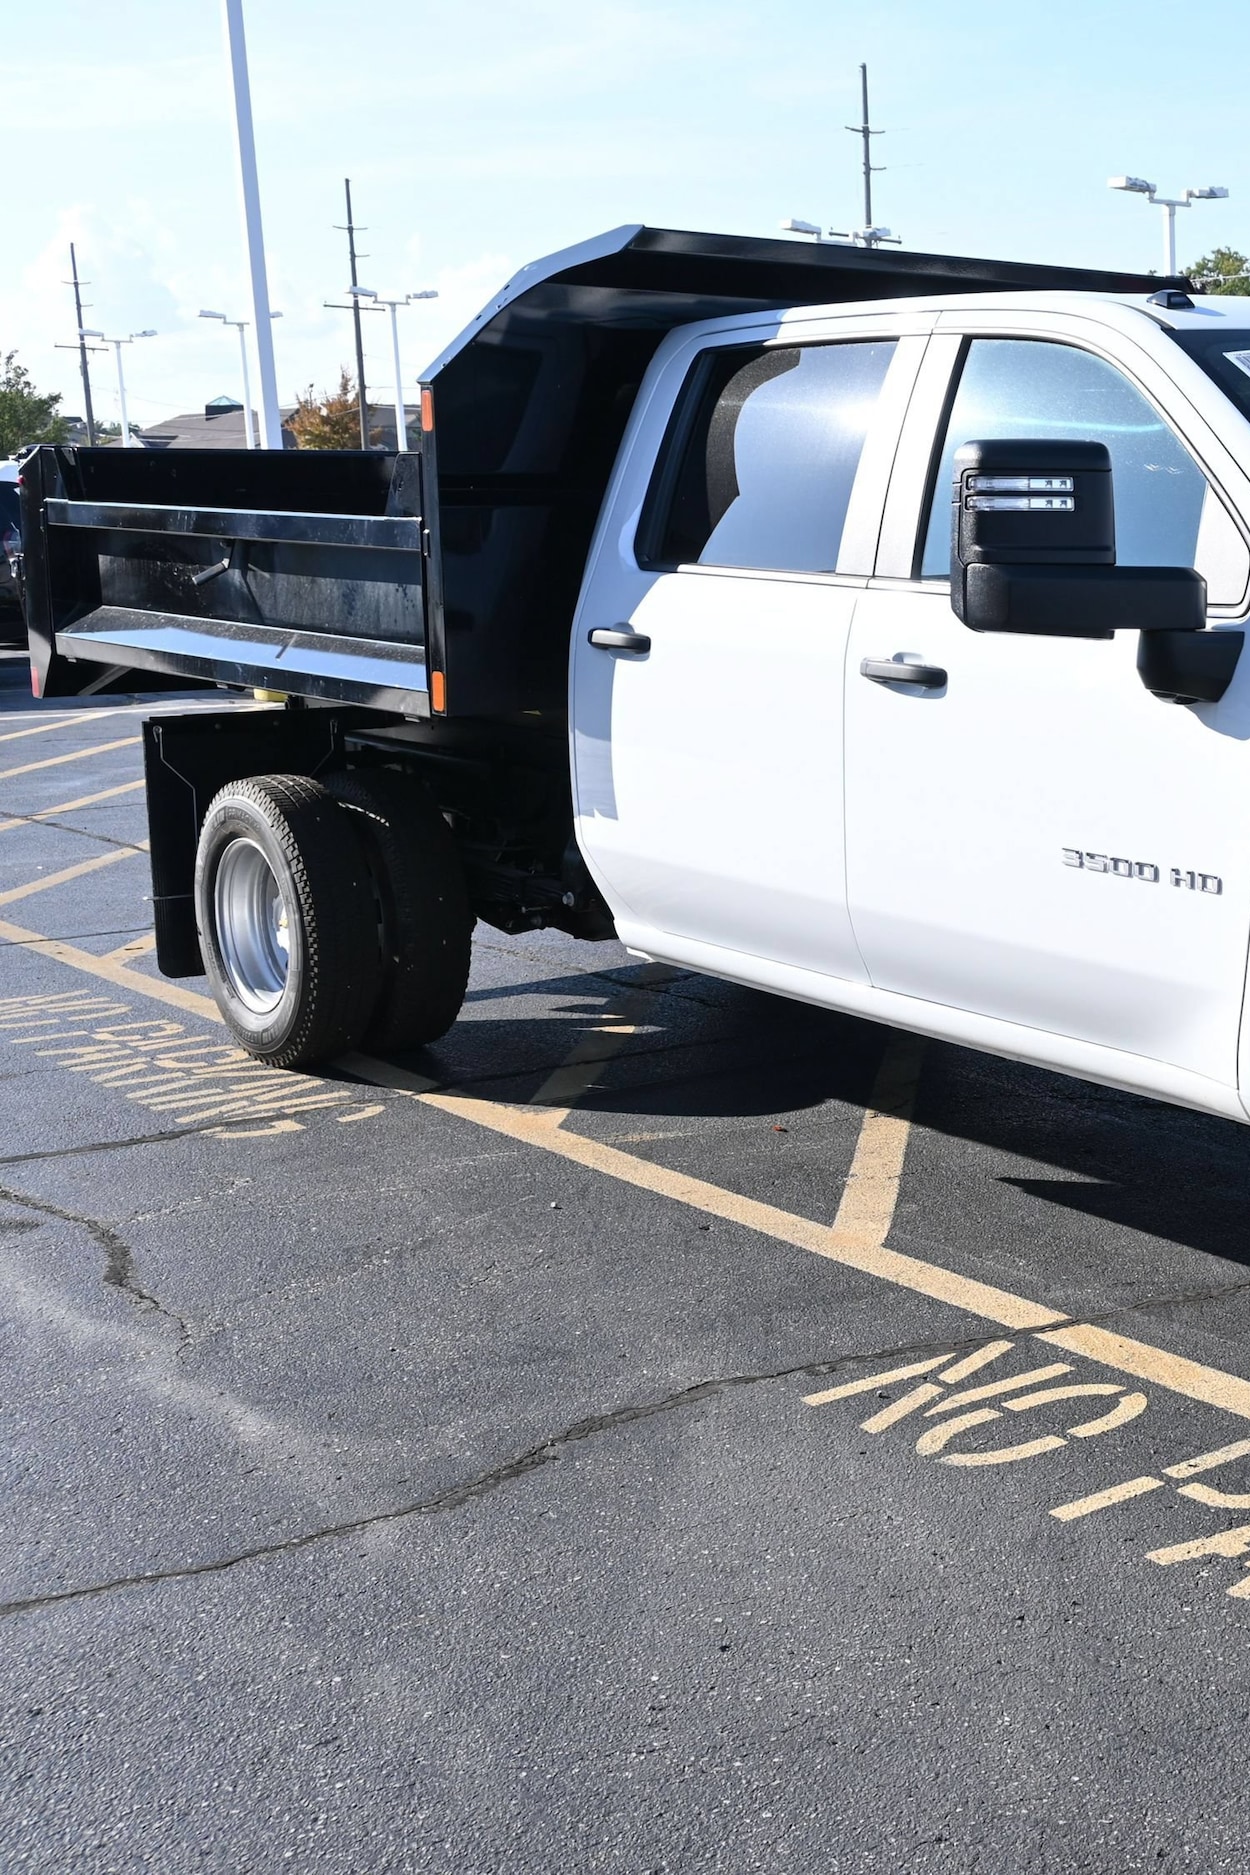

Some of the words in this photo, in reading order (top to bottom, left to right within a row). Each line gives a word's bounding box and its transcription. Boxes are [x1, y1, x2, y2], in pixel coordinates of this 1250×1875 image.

[1061, 847, 1160, 883] 3500
[1170, 868, 1223, 895] HD
[802, 1340, 1148, 1467] NO
